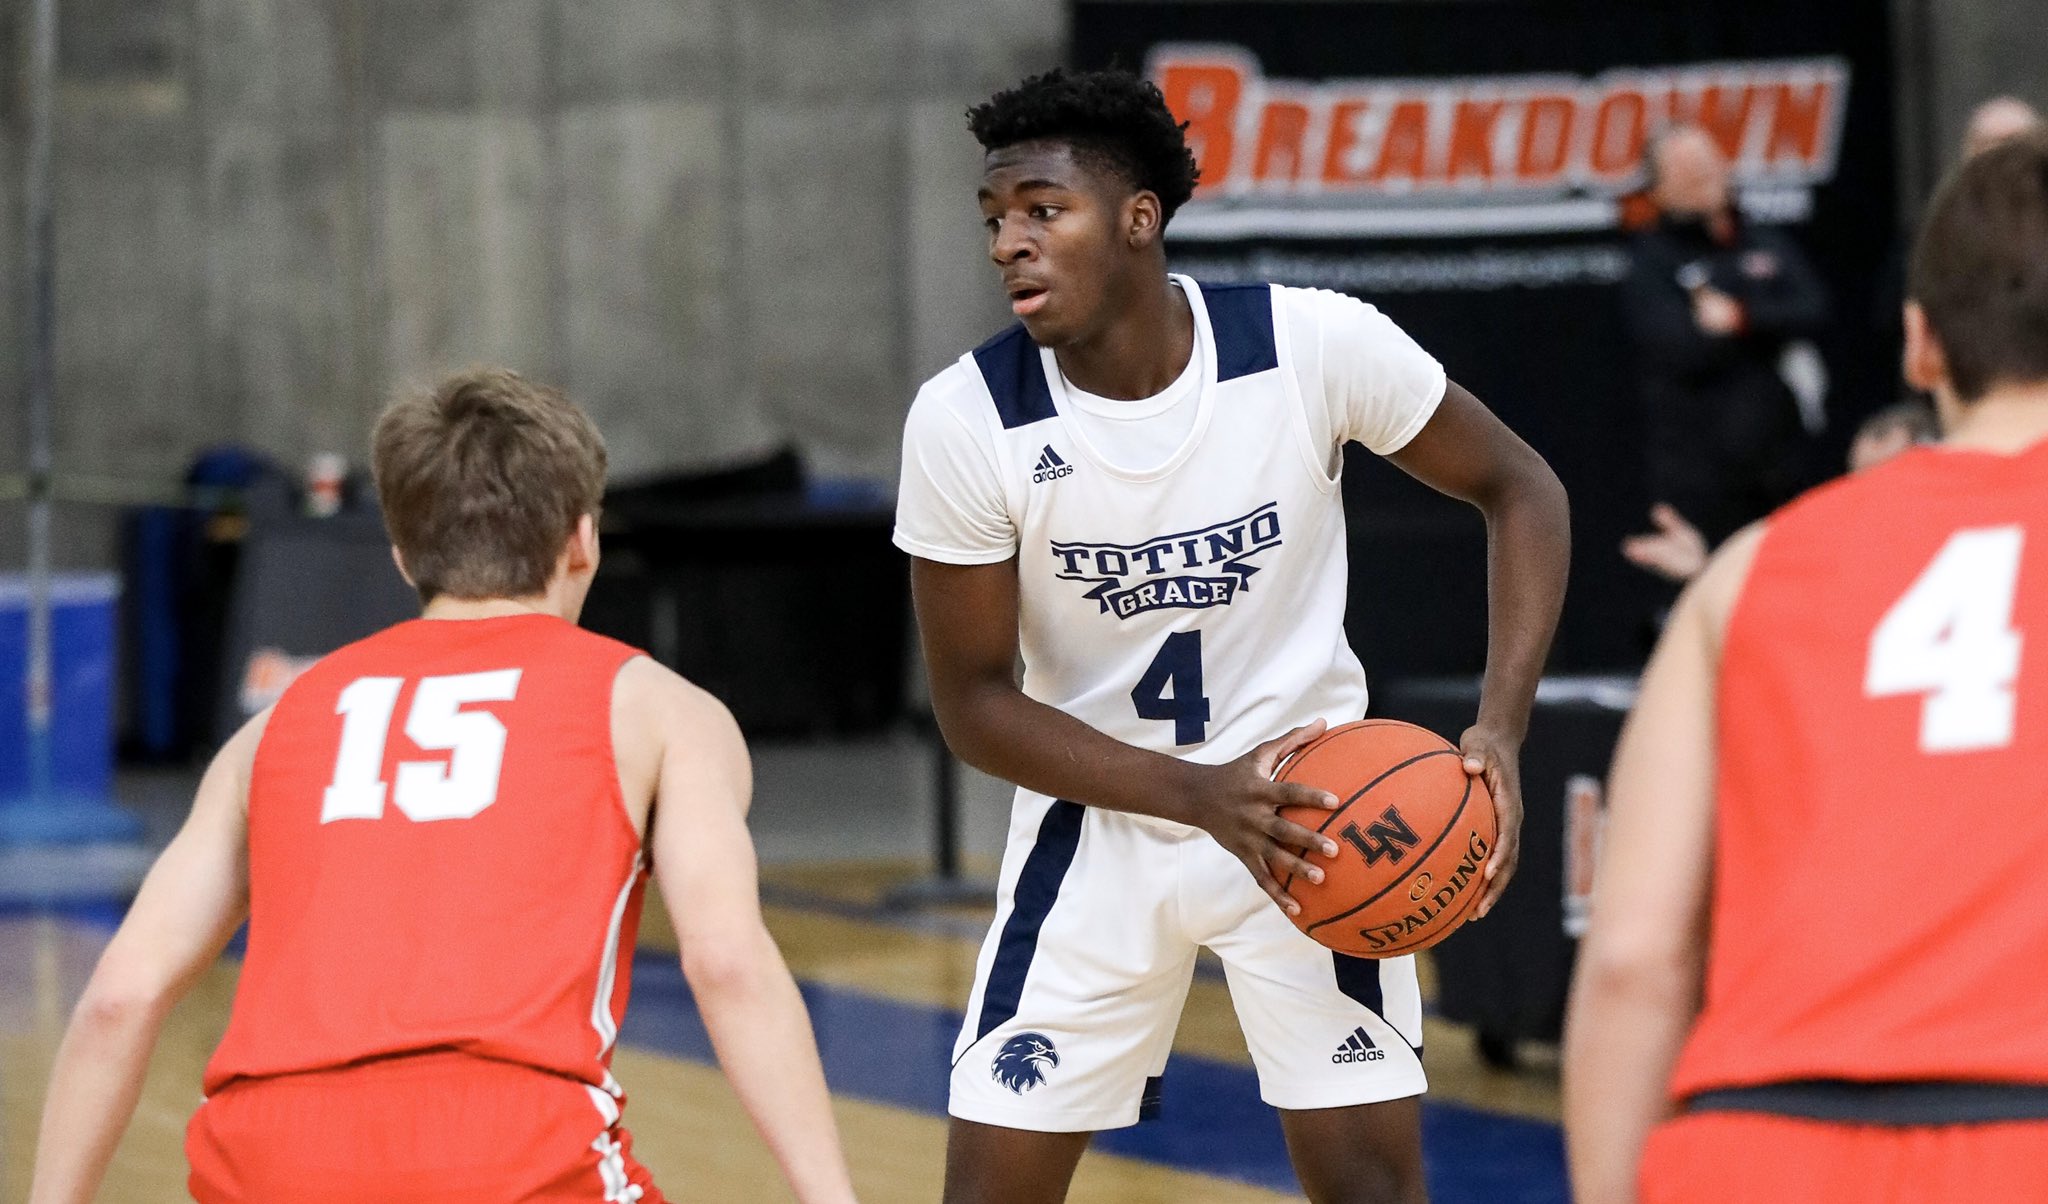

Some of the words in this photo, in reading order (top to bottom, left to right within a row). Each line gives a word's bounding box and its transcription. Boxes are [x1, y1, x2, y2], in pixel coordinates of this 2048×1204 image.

[1051, 511, 1281, 577] TOTINO
[1118, 580, 1229, 615] GRACE
[1865, 524, 2024, 754] 4
[1130, 629, 1211, 746] 4
[320, 668, 523, 824] 15
[1338, 803, 1422, 869] LN
[1359, 831, 1489, 950] SPALDING
[1331, 1047, 1385, 1064] adidas
